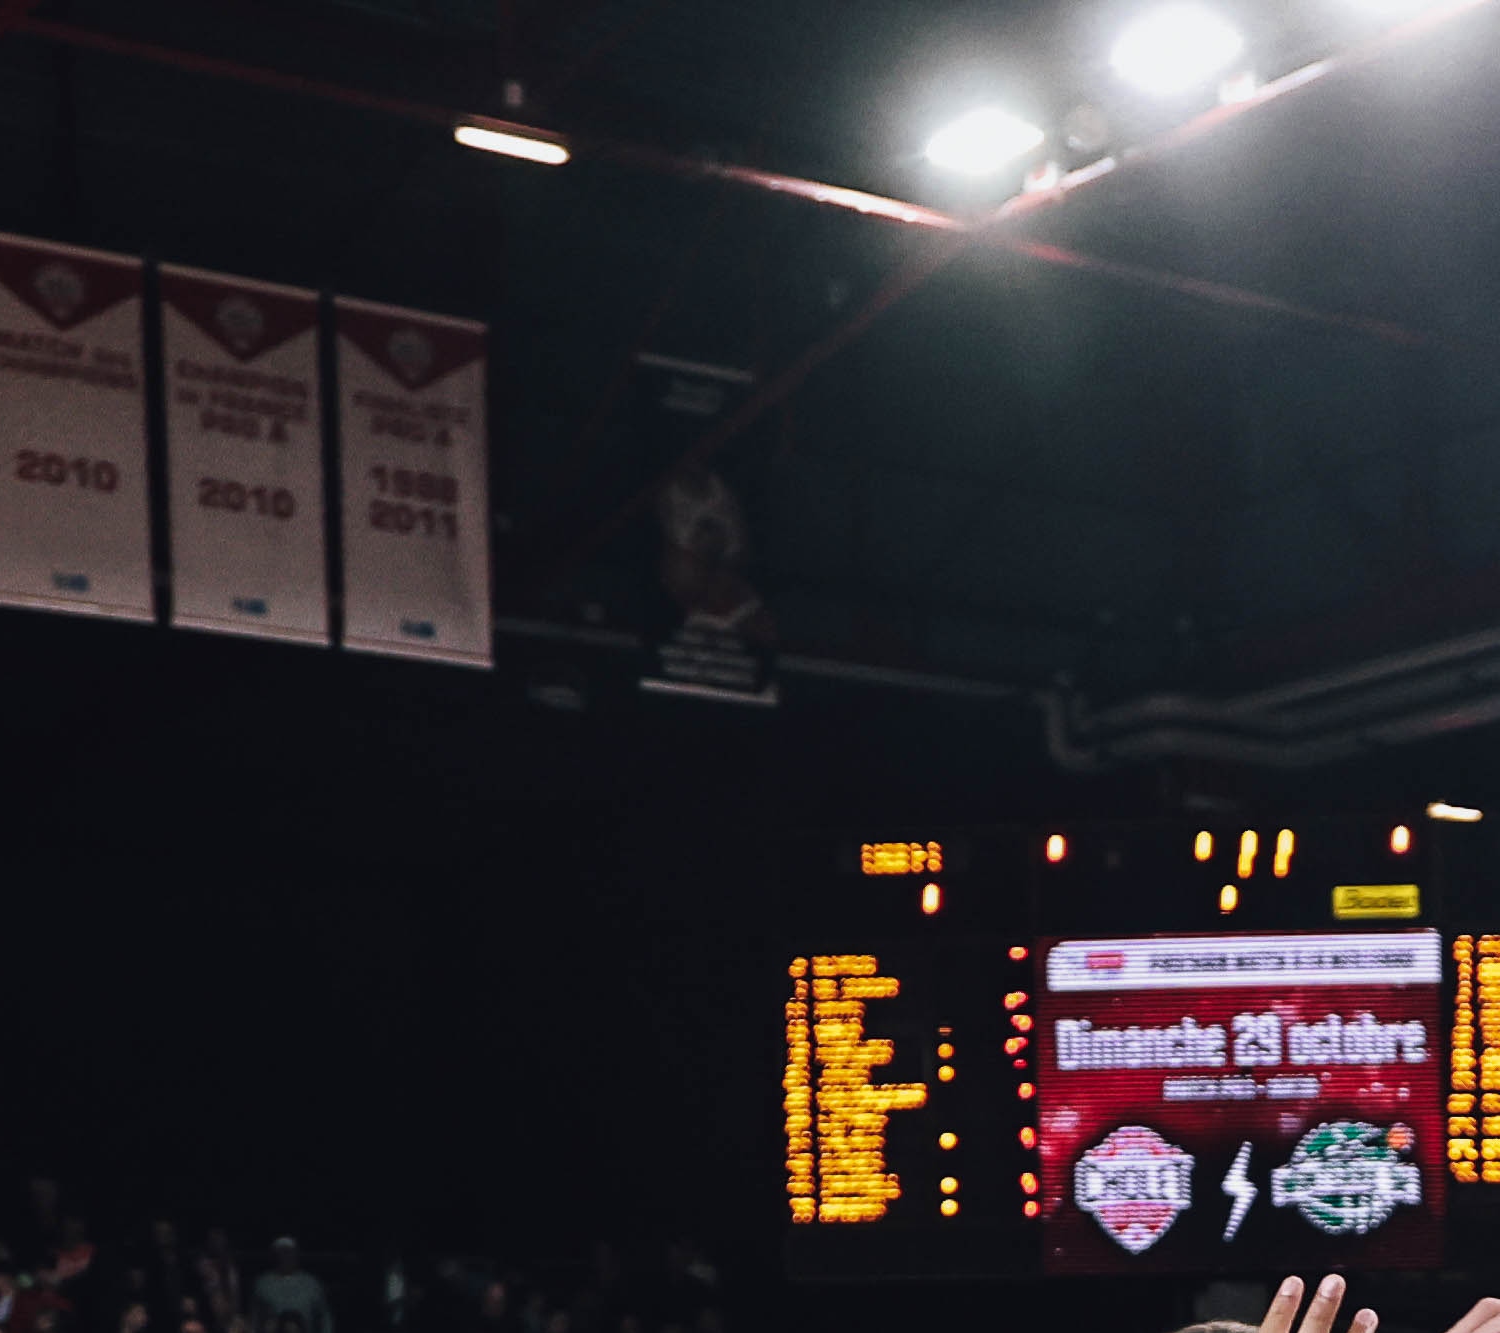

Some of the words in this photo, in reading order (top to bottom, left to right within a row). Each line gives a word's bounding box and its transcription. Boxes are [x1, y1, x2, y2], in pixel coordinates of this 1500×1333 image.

[13, 450, 119, 494] 2010
[199, 476, 296, 521] 2010
[1055, 1018, 1228, 1071] Dimanche
[1232, 1013, 1283, 1067] 29
[1287, 1013, 1428, 1066] octobre
